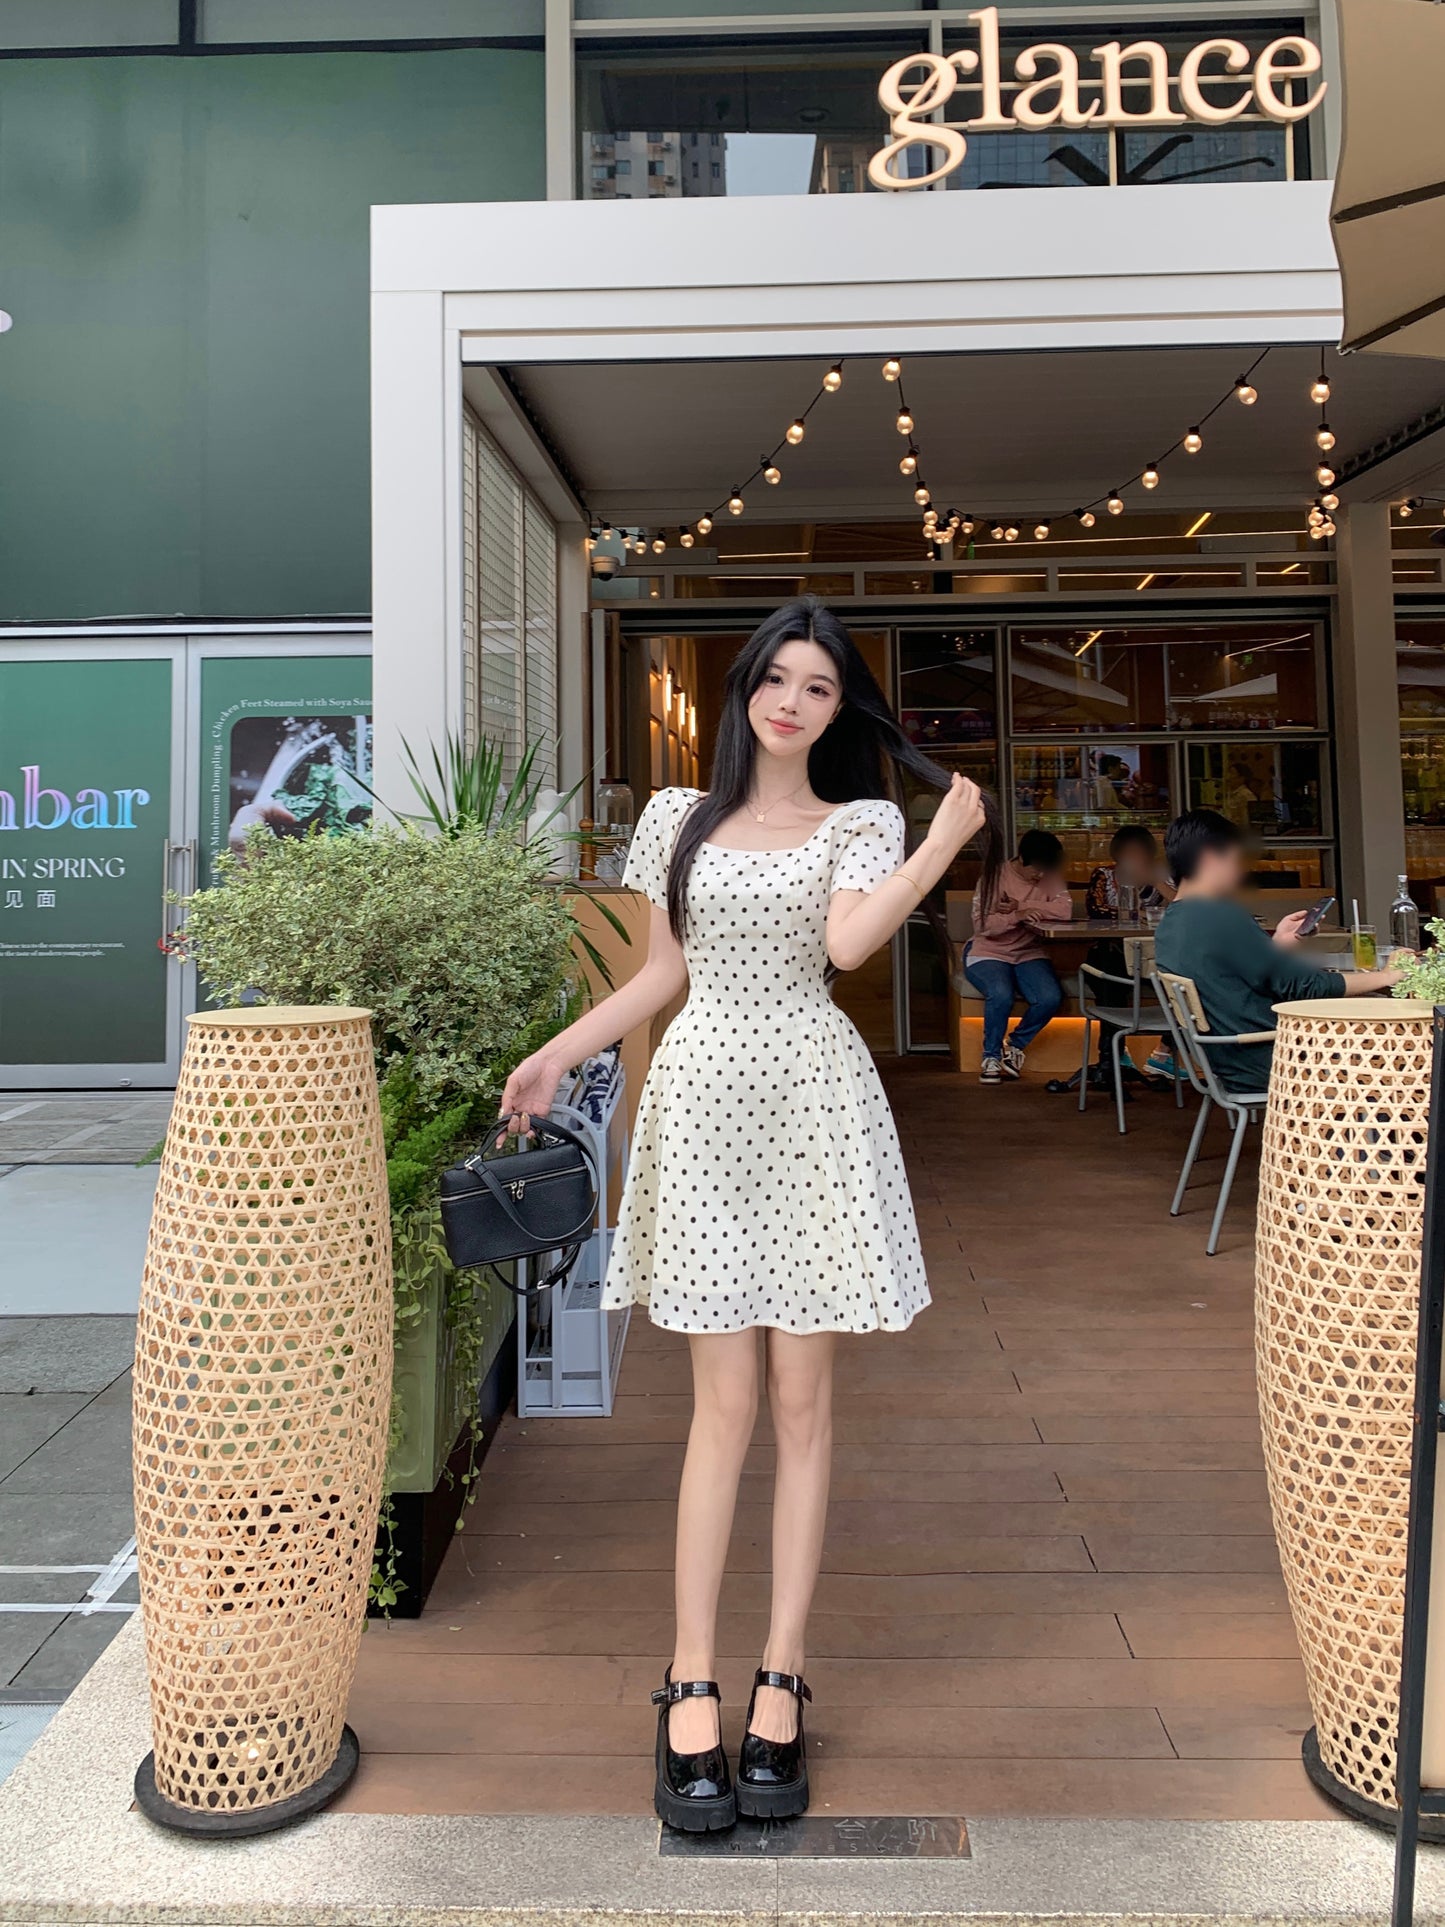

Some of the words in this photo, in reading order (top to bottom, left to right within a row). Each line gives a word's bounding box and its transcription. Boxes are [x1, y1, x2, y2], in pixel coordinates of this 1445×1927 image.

[867, 6, 1329, 192] glance
[240, 699, 262, 708] Feet
[264, 698, 304, 708] Steamed
[305, 698, 328, 707] with
[329, 698, 352, 709] Soya
[353, 698, 373, 707] Sau
[212, 703, 240, 738] Chicken
[211, 745, 224, 792] Dumpling
[210, 795, 220, 846] Mushroom
[2, 858, 28, 879] IN
[32, 857, 126, 879] SPRING
[4, 889, 57, 909] 见面
